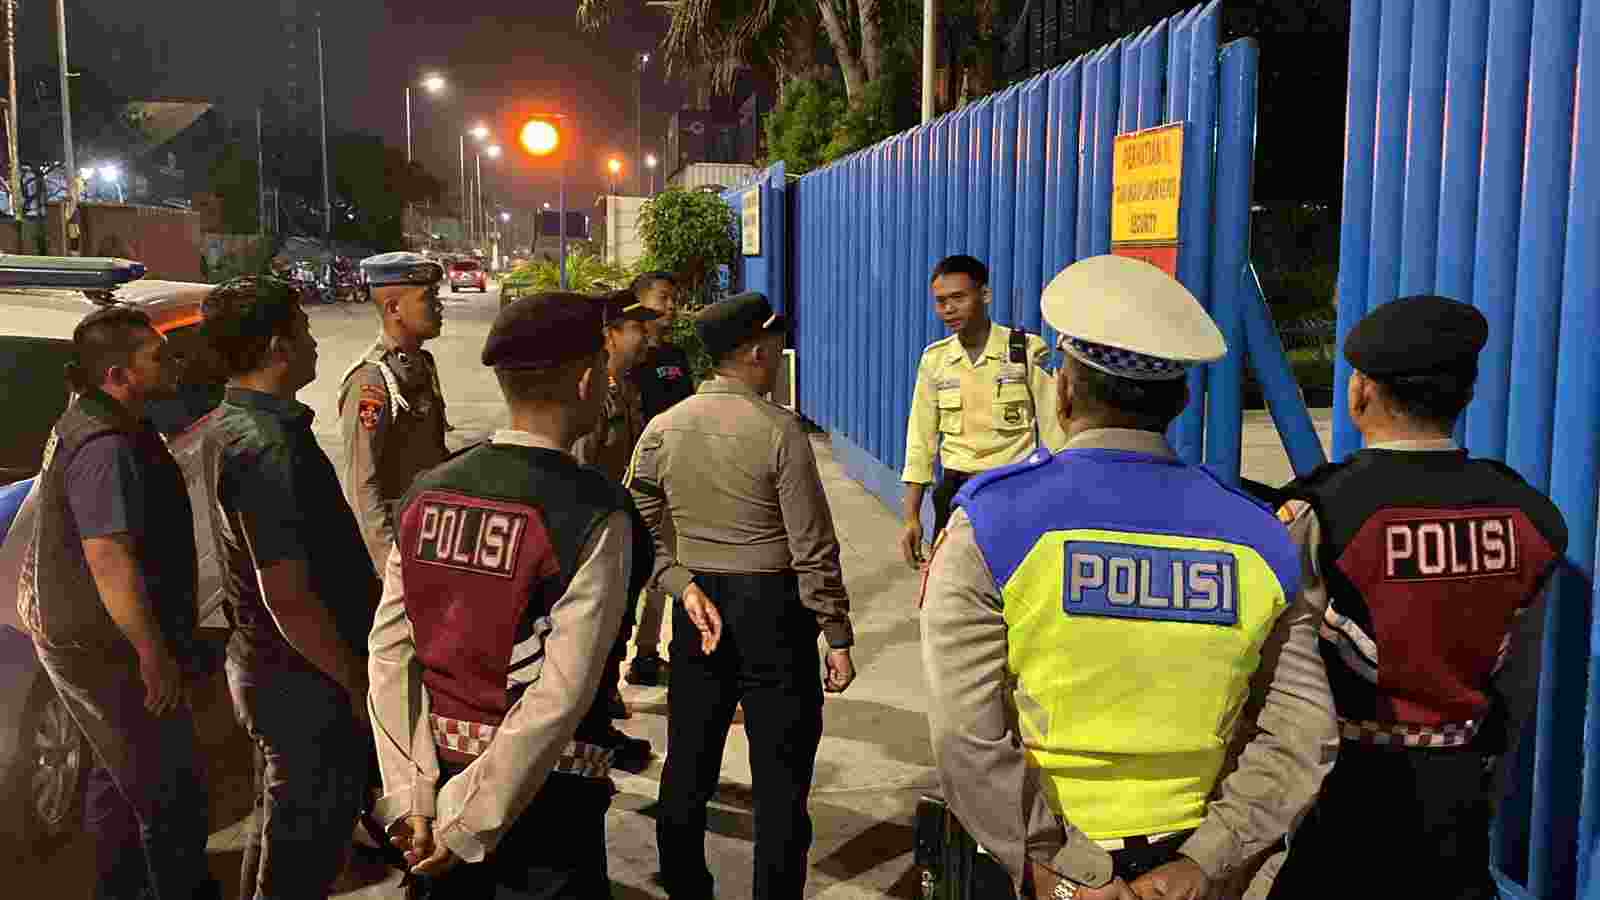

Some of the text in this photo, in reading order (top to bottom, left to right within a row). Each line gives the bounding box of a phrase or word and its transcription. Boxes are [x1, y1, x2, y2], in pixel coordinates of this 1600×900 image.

[417, 505, 521, 570] POLISI
[1385, 518, 1516, 576] POLISI
[1070, 553, 1232, 609] POLISI
